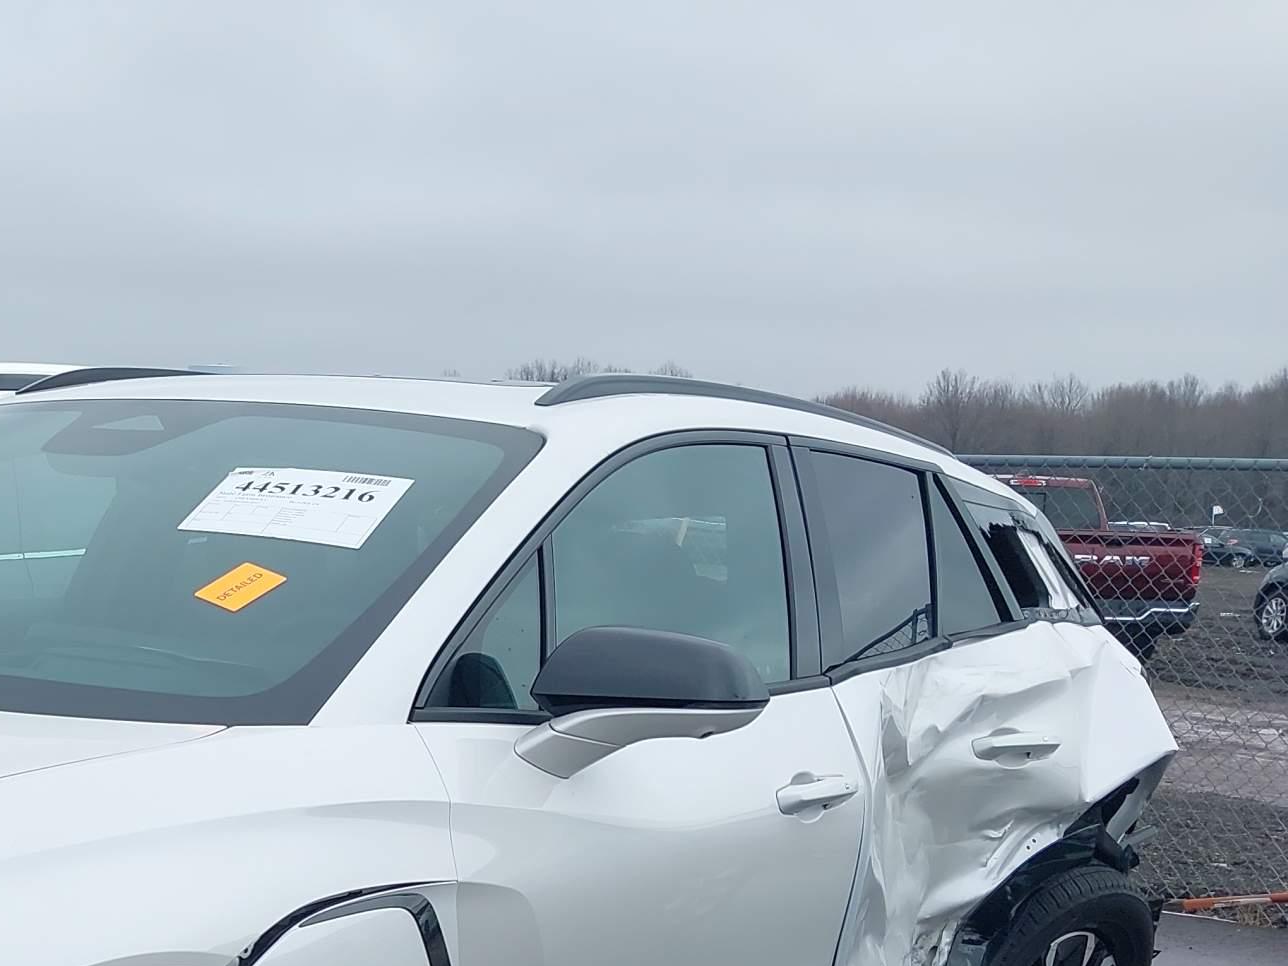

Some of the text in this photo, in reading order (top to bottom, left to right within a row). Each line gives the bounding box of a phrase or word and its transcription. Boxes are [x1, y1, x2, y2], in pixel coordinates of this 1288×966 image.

[235, 480, 383, 503] 44513216
[1073, 554, 1151, 568] RAM
[216, 572, 264, 601] DETAILED
